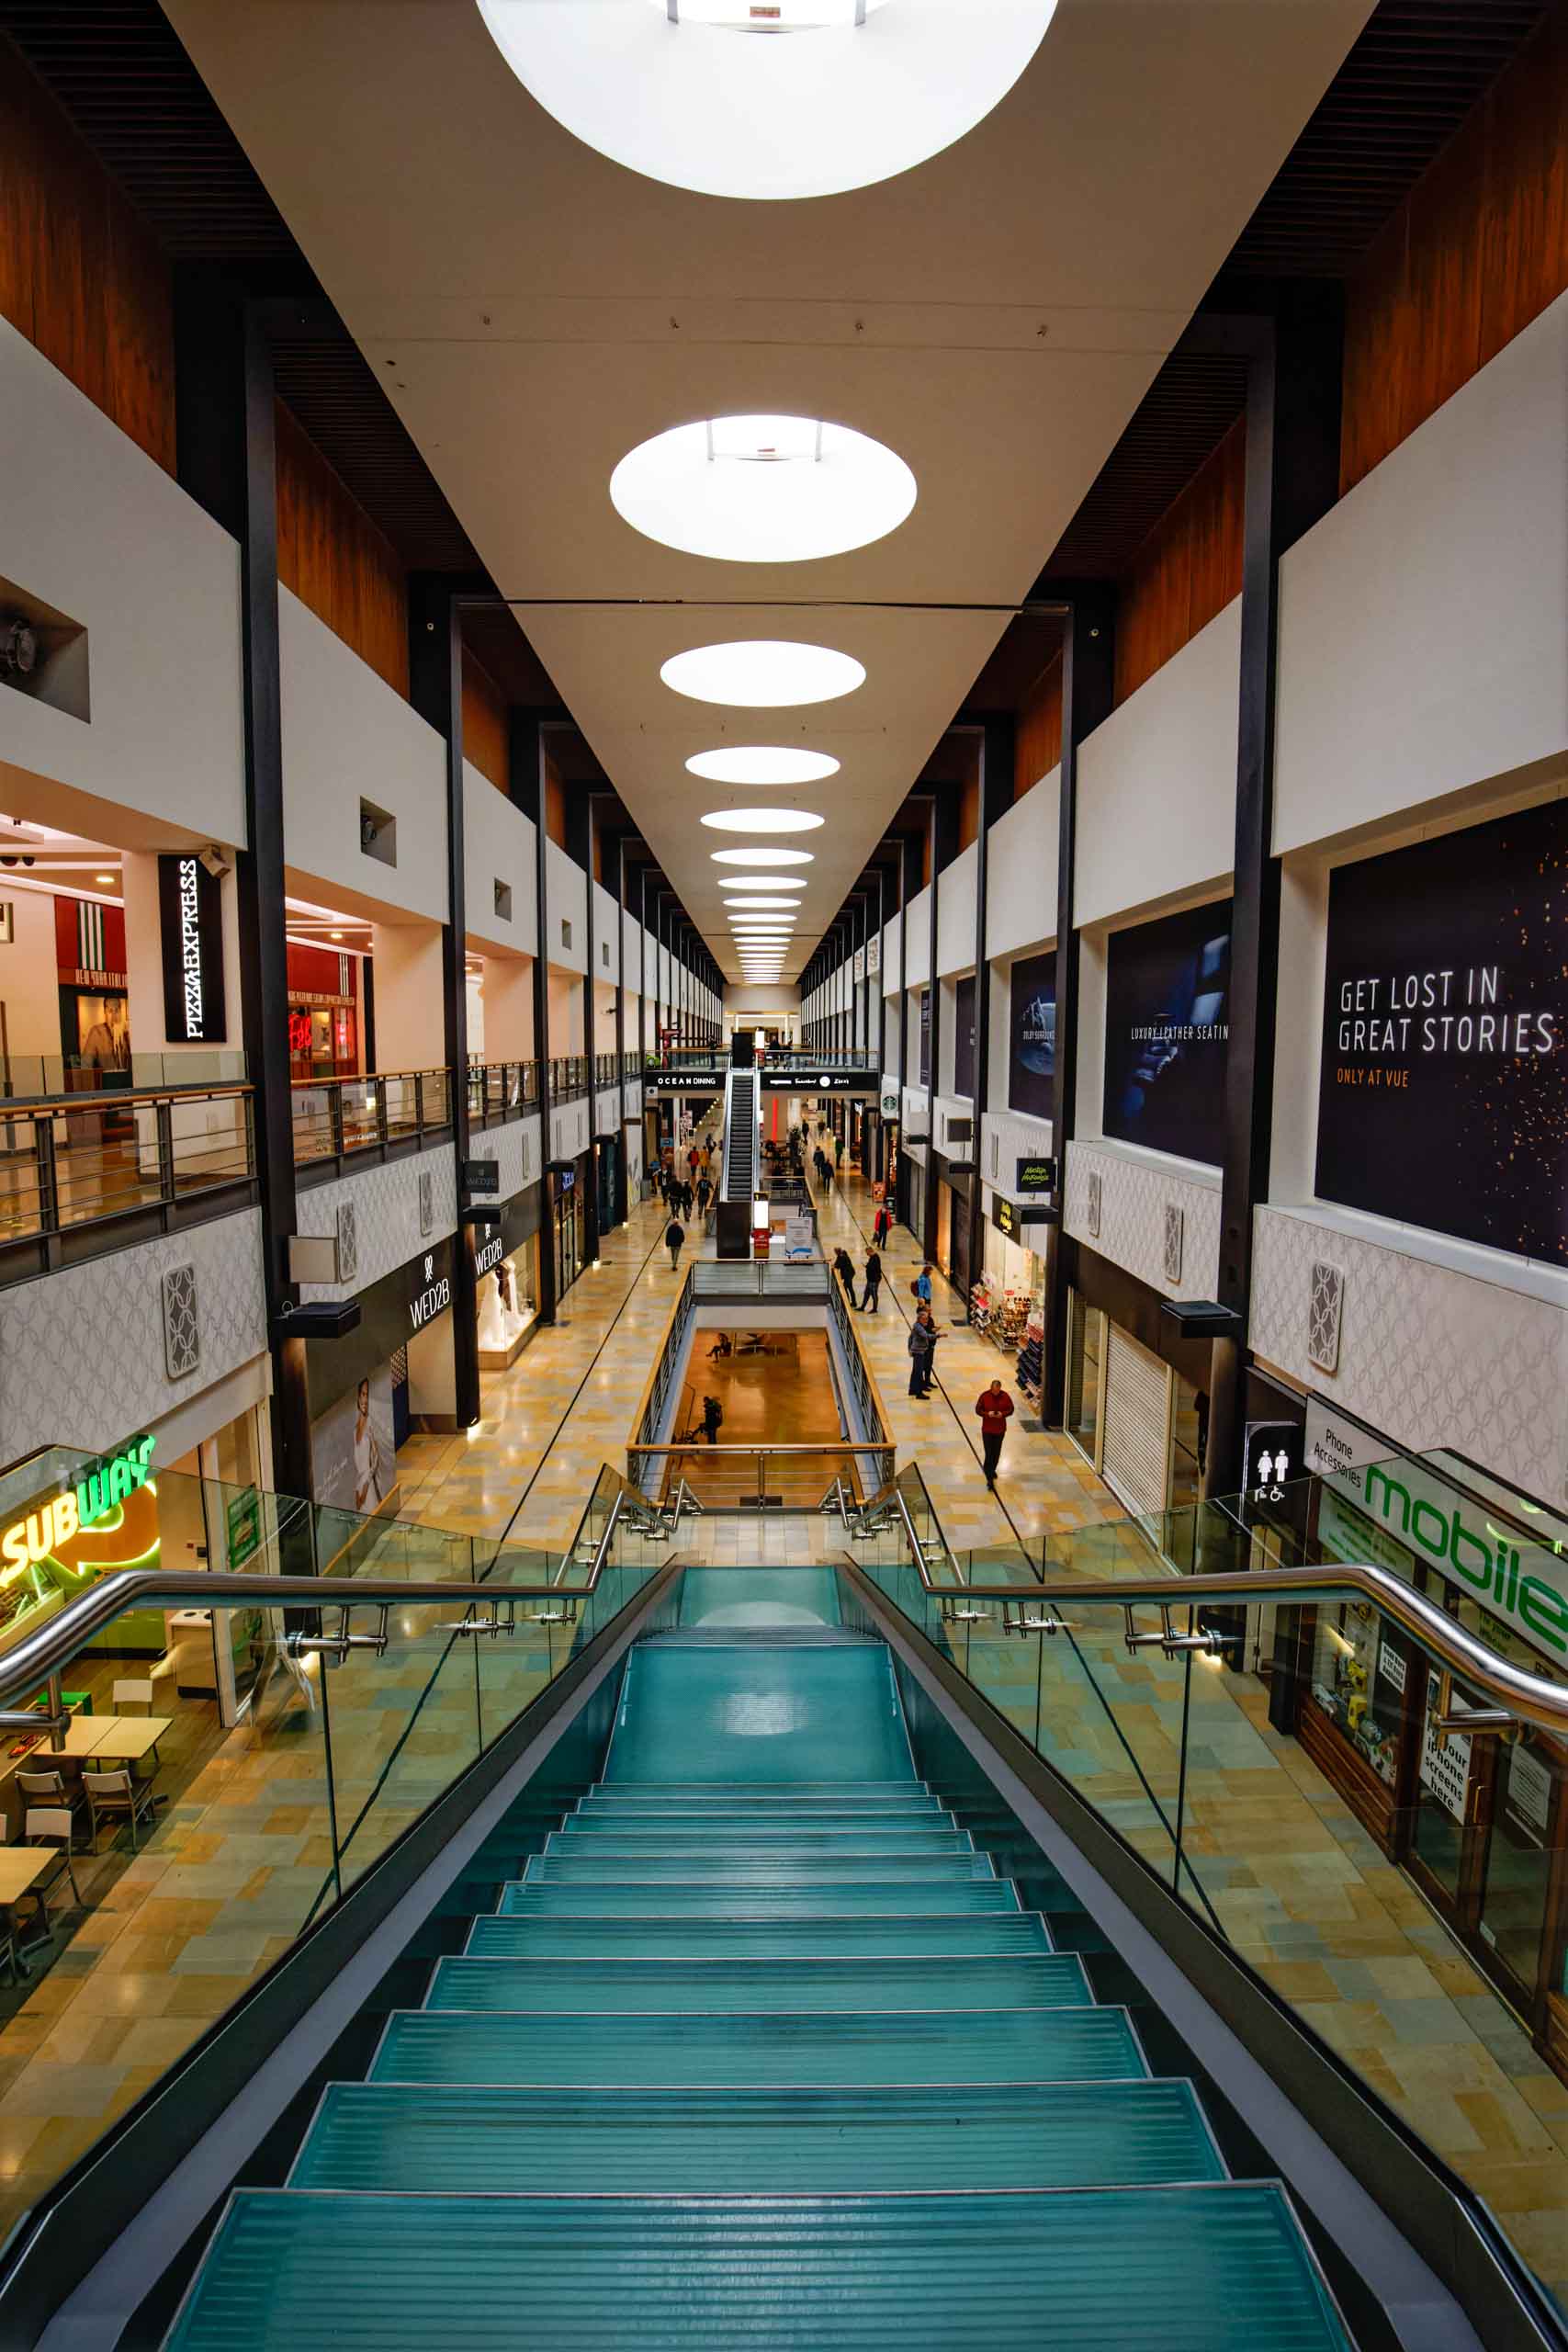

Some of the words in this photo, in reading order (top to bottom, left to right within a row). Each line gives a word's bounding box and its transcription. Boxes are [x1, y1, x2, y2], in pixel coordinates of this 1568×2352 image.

[1341, 979, 1380, 1012] GET
[1391, 971, 1453, 1010] LOST
[1468, 967, 1497, 1005] IN
[1131, 1026, 1156, 1040] LUXURY
[1159, 1025, 1193, 1040] LEATHER
[1197, 1024, 1229, 1040] SEATIN
[1339, 1018, 1411, 1052] GREAT
[1422, 1013, 1554, 1054] STORIES
[1337, 1068, 1364, 1085] ONLY
[1368, 1069, 1382, 1086] AT
[1386, 1070, 1409, 1088] VUE
[475, 1238, 502, 1276] WED2B
[410, 1278, 450, 1329] WED2B
[1314, 1442, 1361, 1487] Accessories
[1325, 1428, 1353, 1460] Phone
[0, 1434, 156, 1588] SUBWAY
[1364, 1465, 1568, 1652] mobile
[1425, 1756, 1463, 1802] screens
[1430, 1776, 1455, 1810] here
